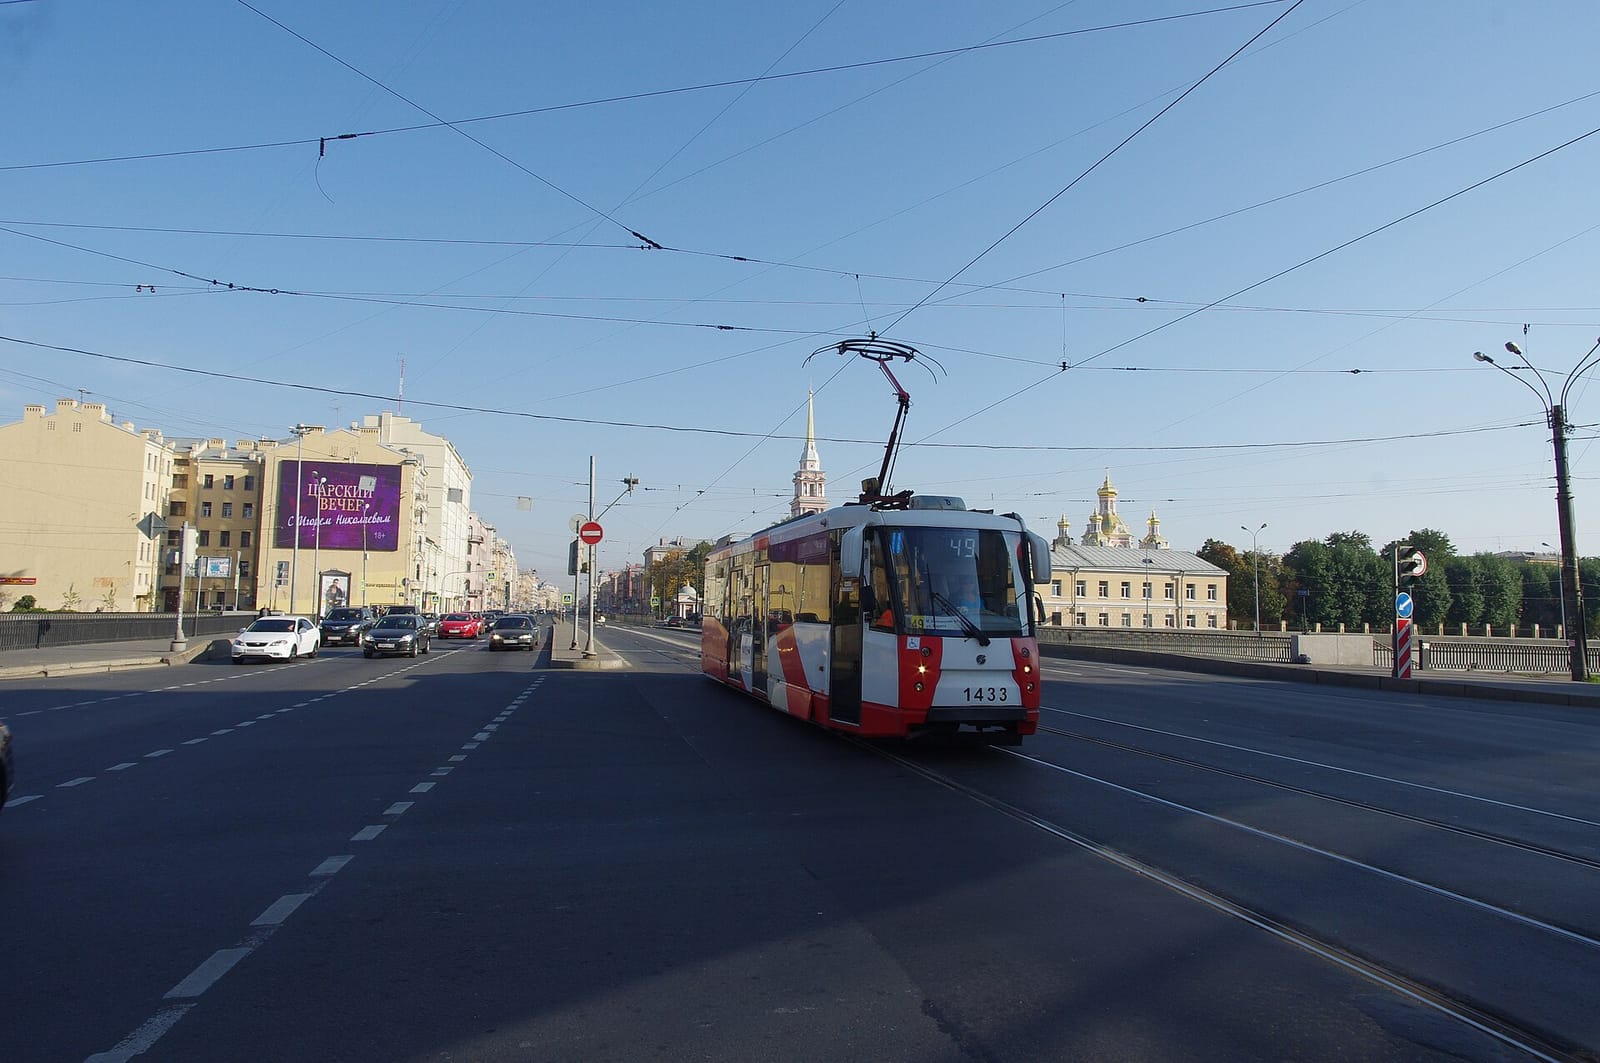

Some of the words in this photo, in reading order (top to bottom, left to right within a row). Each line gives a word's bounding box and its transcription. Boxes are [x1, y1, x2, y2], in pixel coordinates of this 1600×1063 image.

[319, 497, 364, 512] ВЕЧЕР
[336, 512, 391, 525] Николаевым
[374, 531, 386, 540] 18+
[950, 538, 975, 558] 49
[911, 618, 924, 630] 49
[963, 687, 1008, 702] 1433
